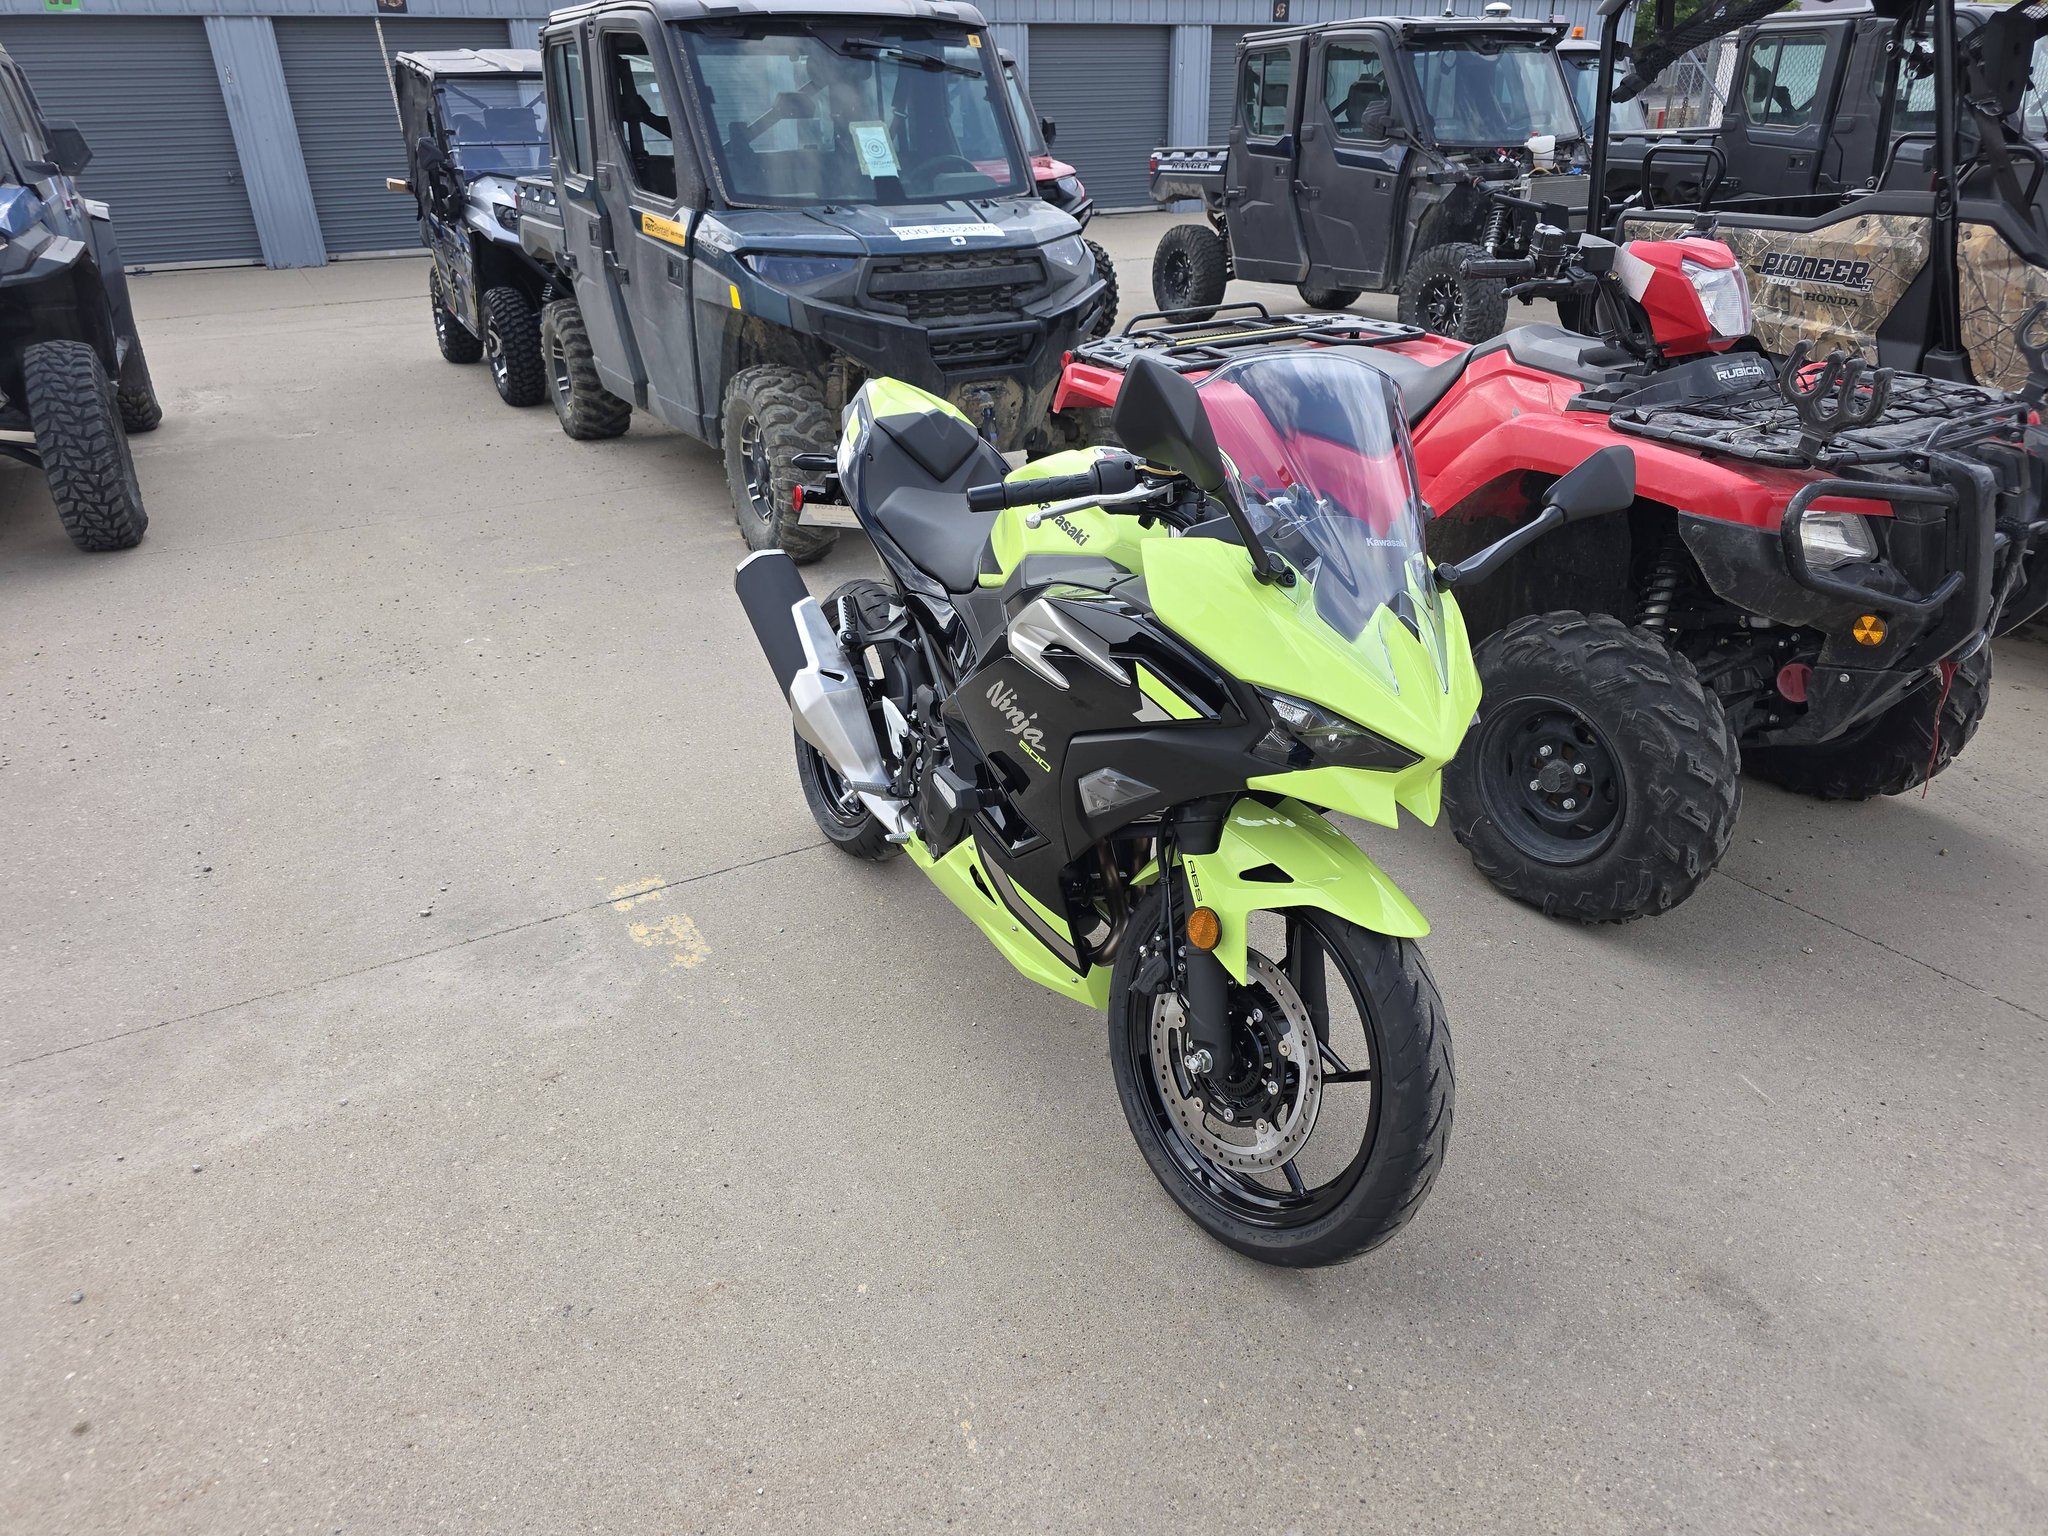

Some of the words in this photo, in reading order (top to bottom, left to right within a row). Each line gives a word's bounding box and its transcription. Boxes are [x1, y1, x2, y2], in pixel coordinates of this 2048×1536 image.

[1171, 160, 1212, 170] RANGER
[700, 224, 732, 246] XP
[1760, 252, 1871, 285] PIONEER
[1804, 292, 1859, 307] HONDA
[1716, 366, 1766, 381] RUBICON
[1365, 537, 1408, 548] Kawasaki
[986, 680, 1046, 752] Ninja
[1019, 739, 1052, 773] 500
[1188, 860, 1203, 902] ABS
